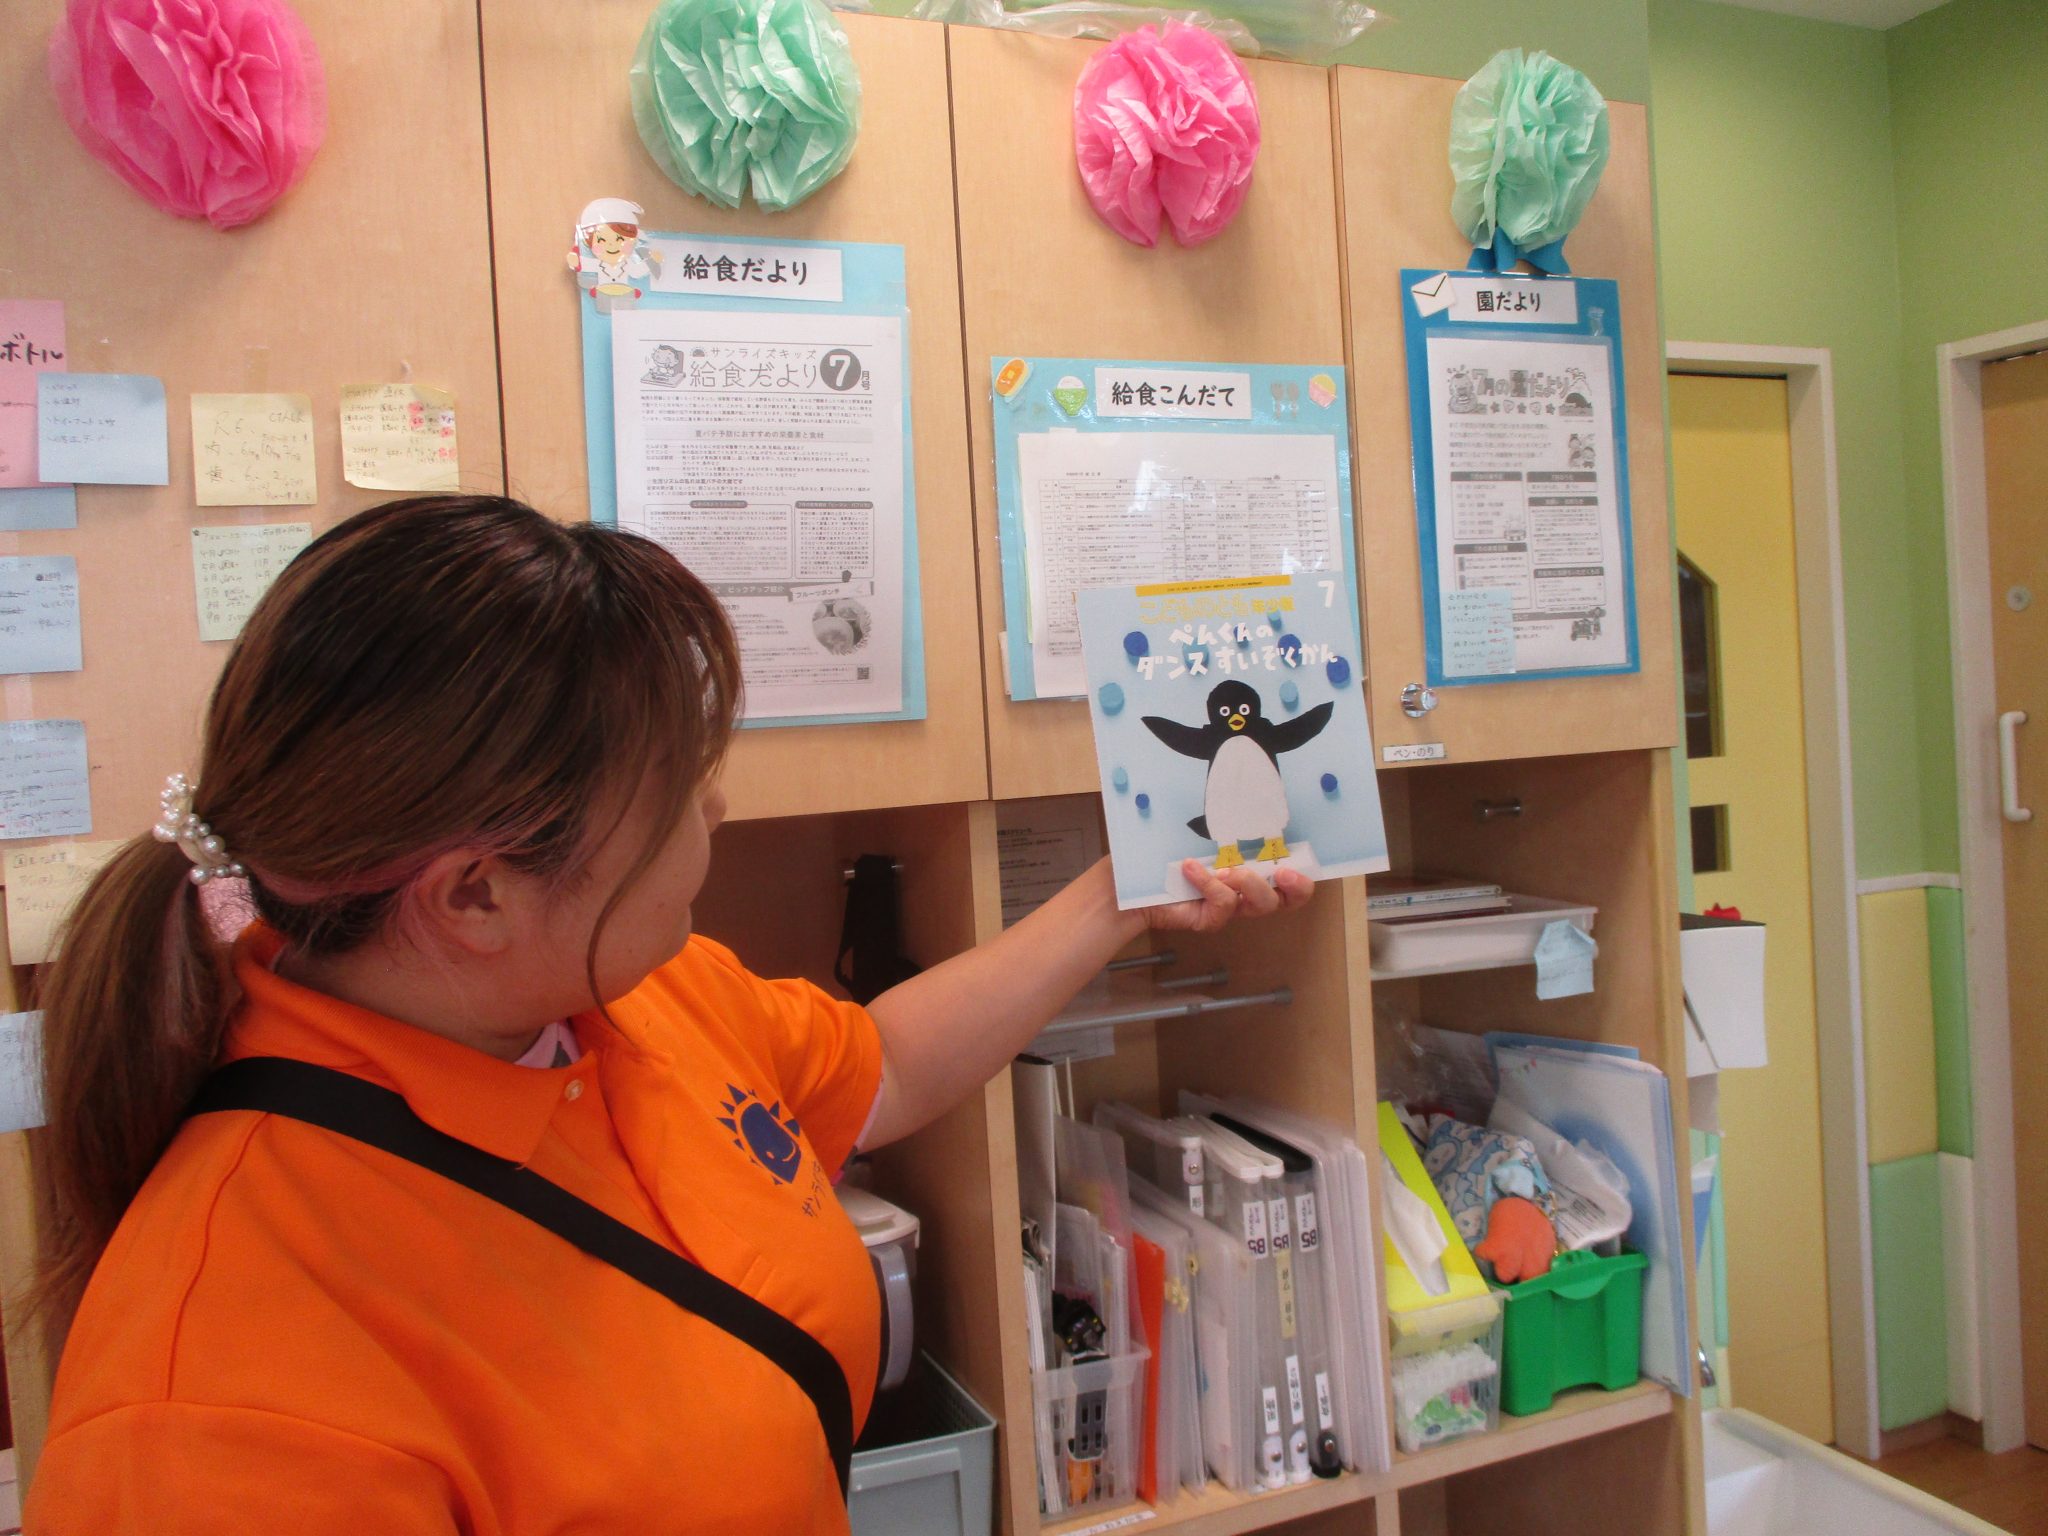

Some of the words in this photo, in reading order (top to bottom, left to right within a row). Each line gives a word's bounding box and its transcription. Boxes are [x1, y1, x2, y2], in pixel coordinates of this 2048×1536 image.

[683, 253, 808, 286] 給食だより
[1476, 290, 1541, 313] 園だより
[0, 333, 64, 366] ボトル
[710, 347, 817, 360] サンライズキッズ
[690, 361, 817, 389] 給食だより
[829, 354, 851, 387] 7
[1112, 381, 1237, 408] 給食こんだて
[1318, 580, 1335, 608] 7
[1168, 622, 1274, 646] ぺんくんの
[1136, 652, 1209, 681] ダンス
[1215, 643, 1338, 675] すいぞくかん
